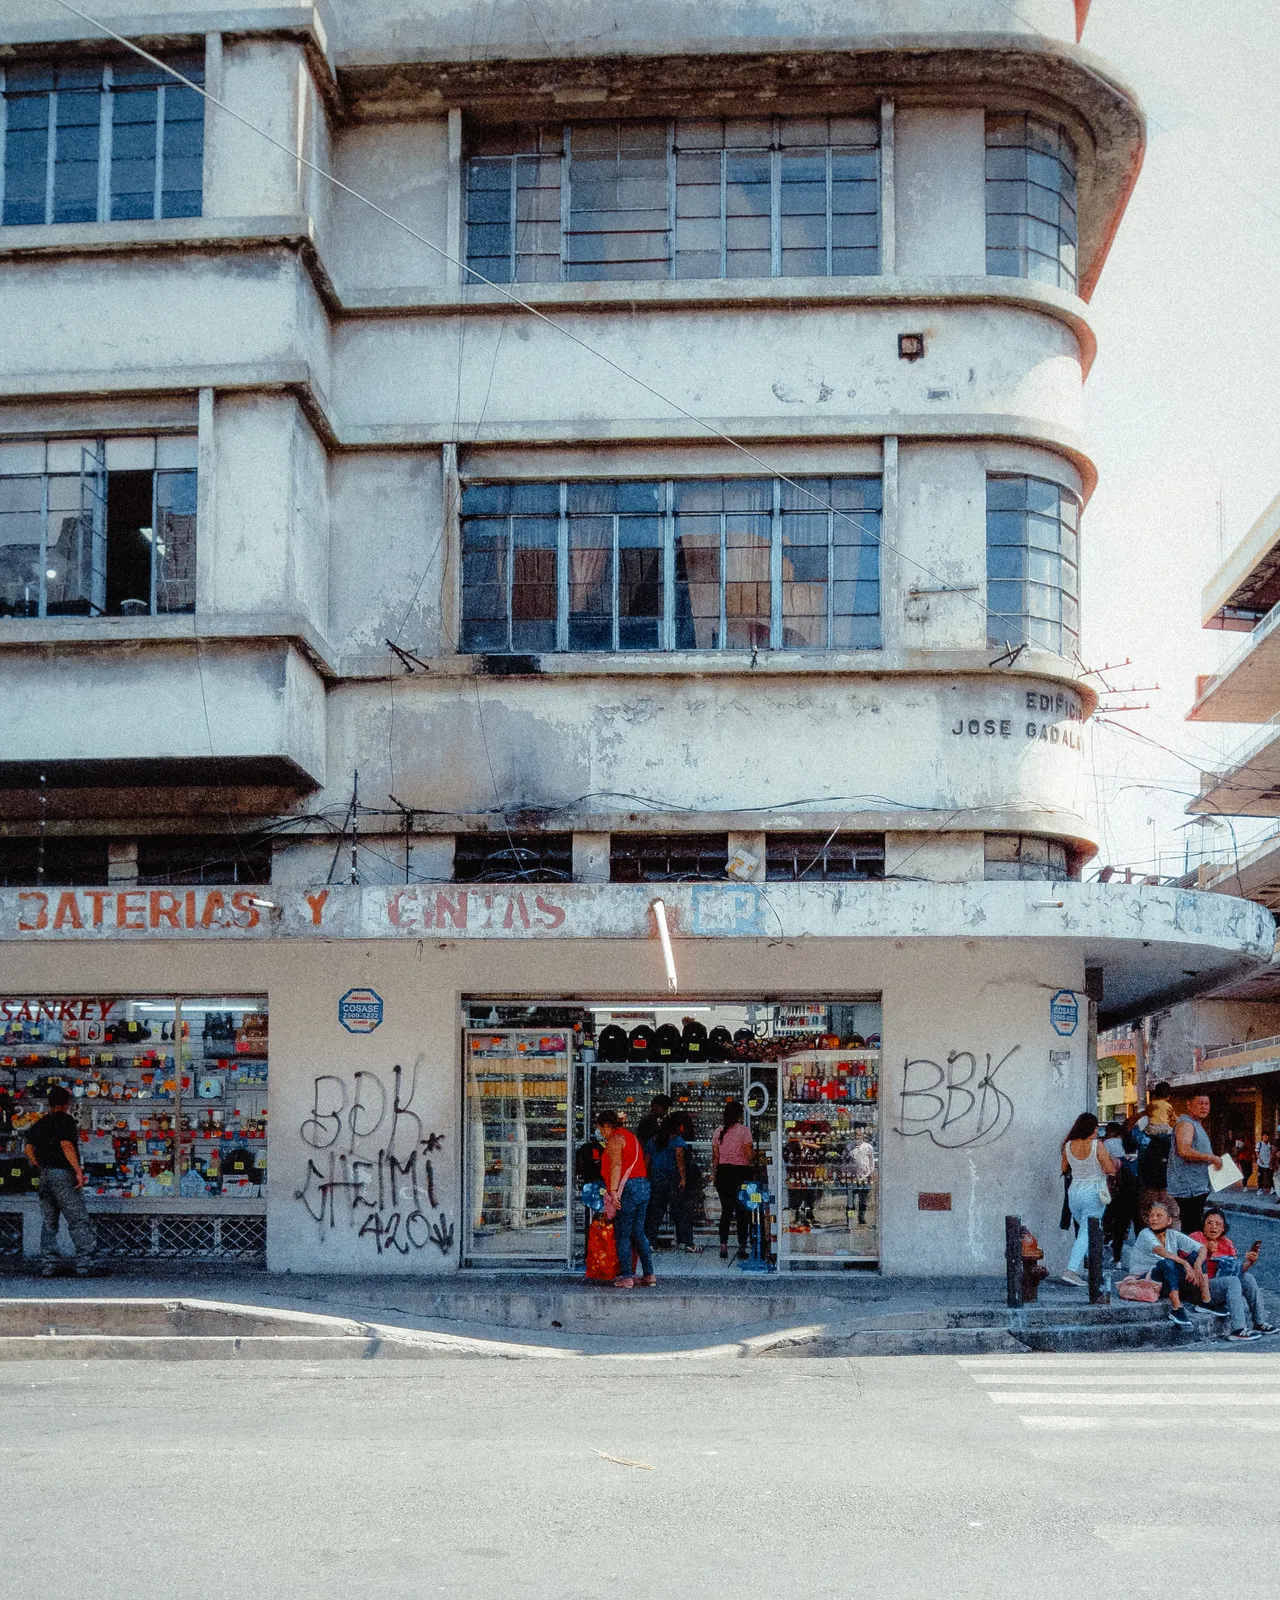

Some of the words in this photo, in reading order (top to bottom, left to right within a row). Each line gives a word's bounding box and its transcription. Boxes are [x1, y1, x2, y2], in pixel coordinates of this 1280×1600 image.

[951, 719, 1012, 738] JOSE
[304, 889, 331, 926] Y
[0, 999, 116, 1023] SANKEY
[342, 1004, 380, 1013] COSASE
[1053, 1006, 1077, 1016] COSASE
